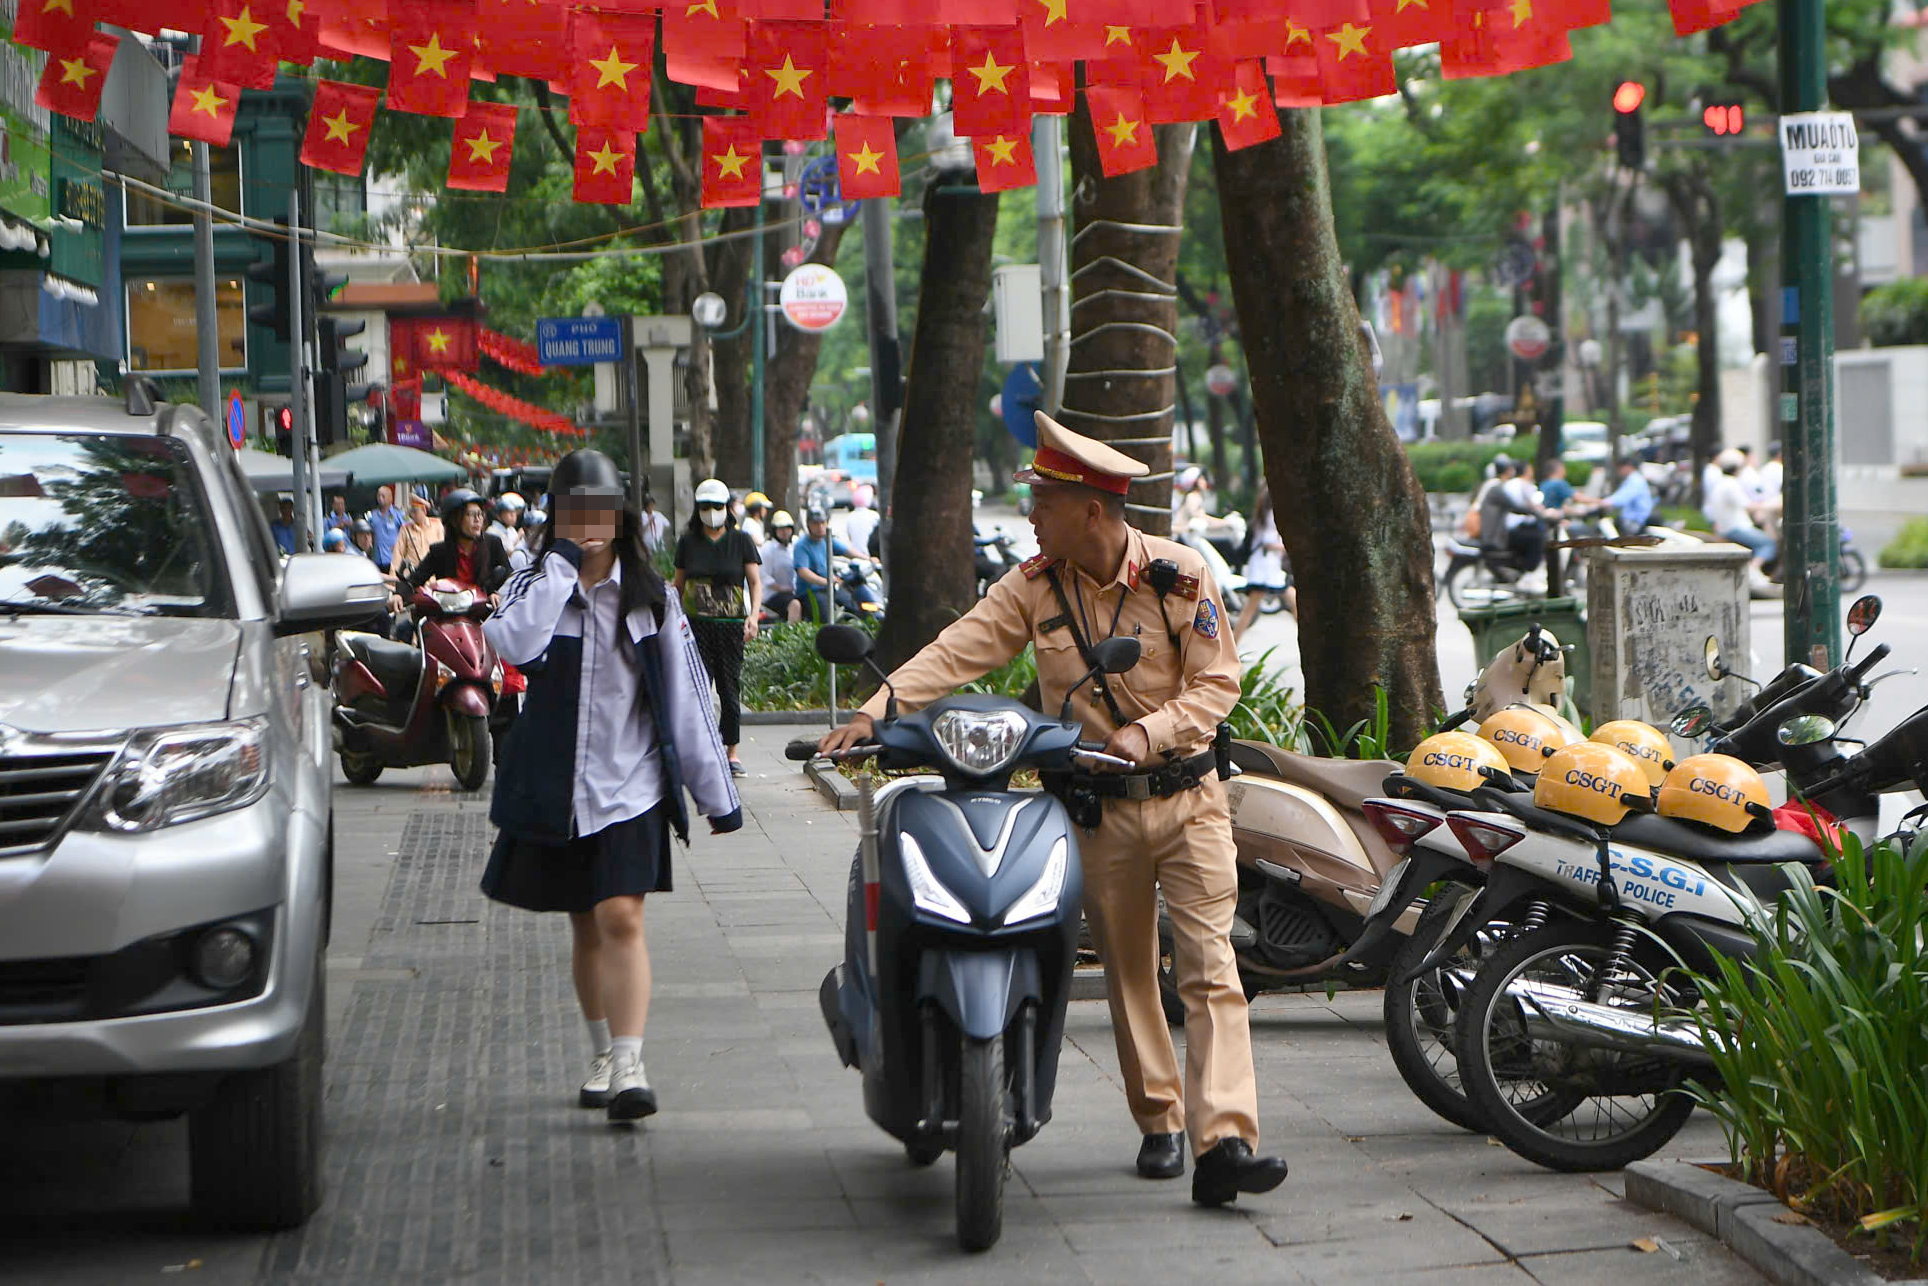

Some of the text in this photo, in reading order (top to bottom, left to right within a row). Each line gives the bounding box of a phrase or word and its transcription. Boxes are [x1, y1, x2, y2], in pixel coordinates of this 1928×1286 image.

[1791, 169, 1815, 187] 092
[545, 338, 615, 359] QUANG TRUNG
[1494, 728, 1542, 751] CSGT
[1423, 752, 1475, 771] CSGT
[1616, 741, 1662, 763] CSGT
[1565, 769, 1622, 799] CSGT
[1689, 777, 1745, 806] CSGT
[1556, 859, 1676, 909] TRAFF POLICE
